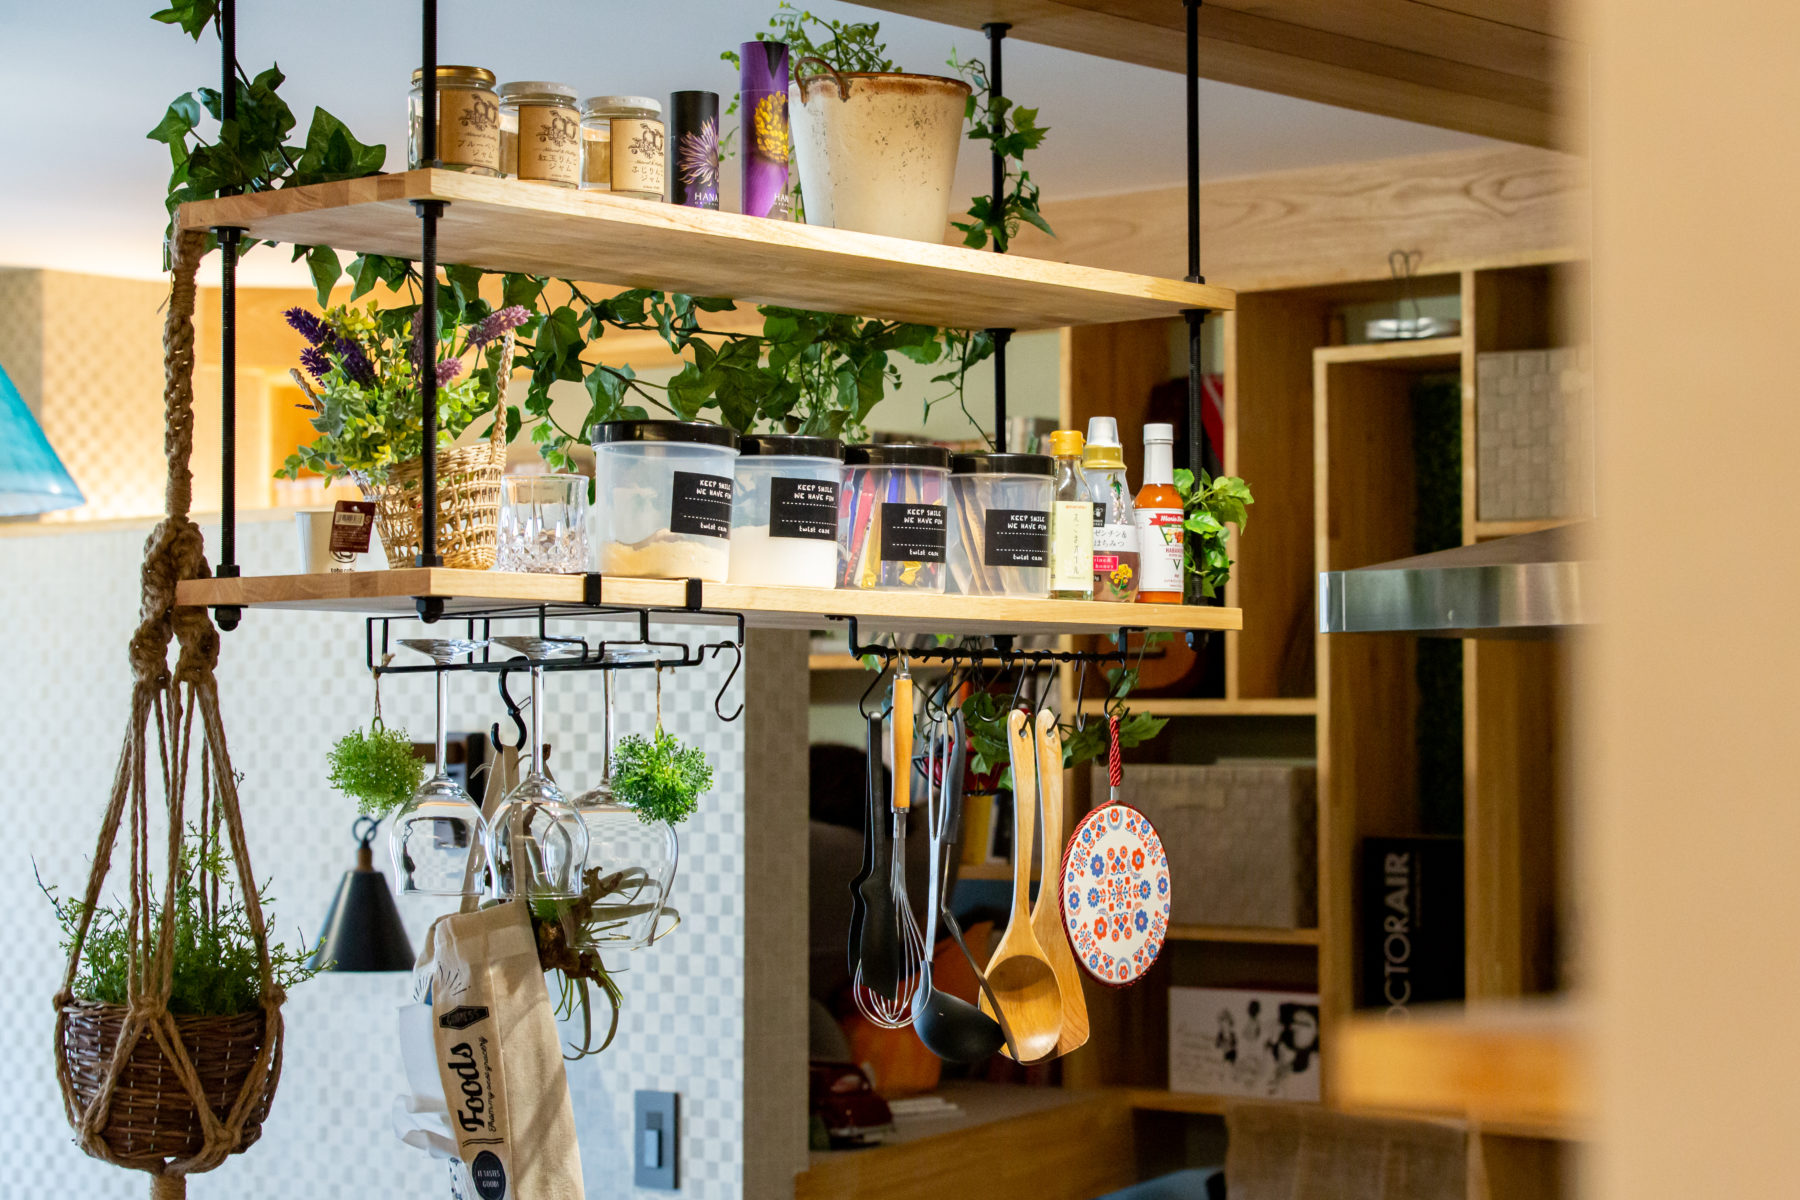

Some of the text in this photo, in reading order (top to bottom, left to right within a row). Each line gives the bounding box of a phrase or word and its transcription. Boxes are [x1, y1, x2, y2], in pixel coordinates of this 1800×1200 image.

[700, 480, 717, 488] KEEP
[710, 490, 723, 498] HAVE
[807, 493, 823, 501] HAVE
[700, 522, 716, 530] twist
[799, 525, 816, 533] twist
[447, 1042, 485, 1133] Foods
